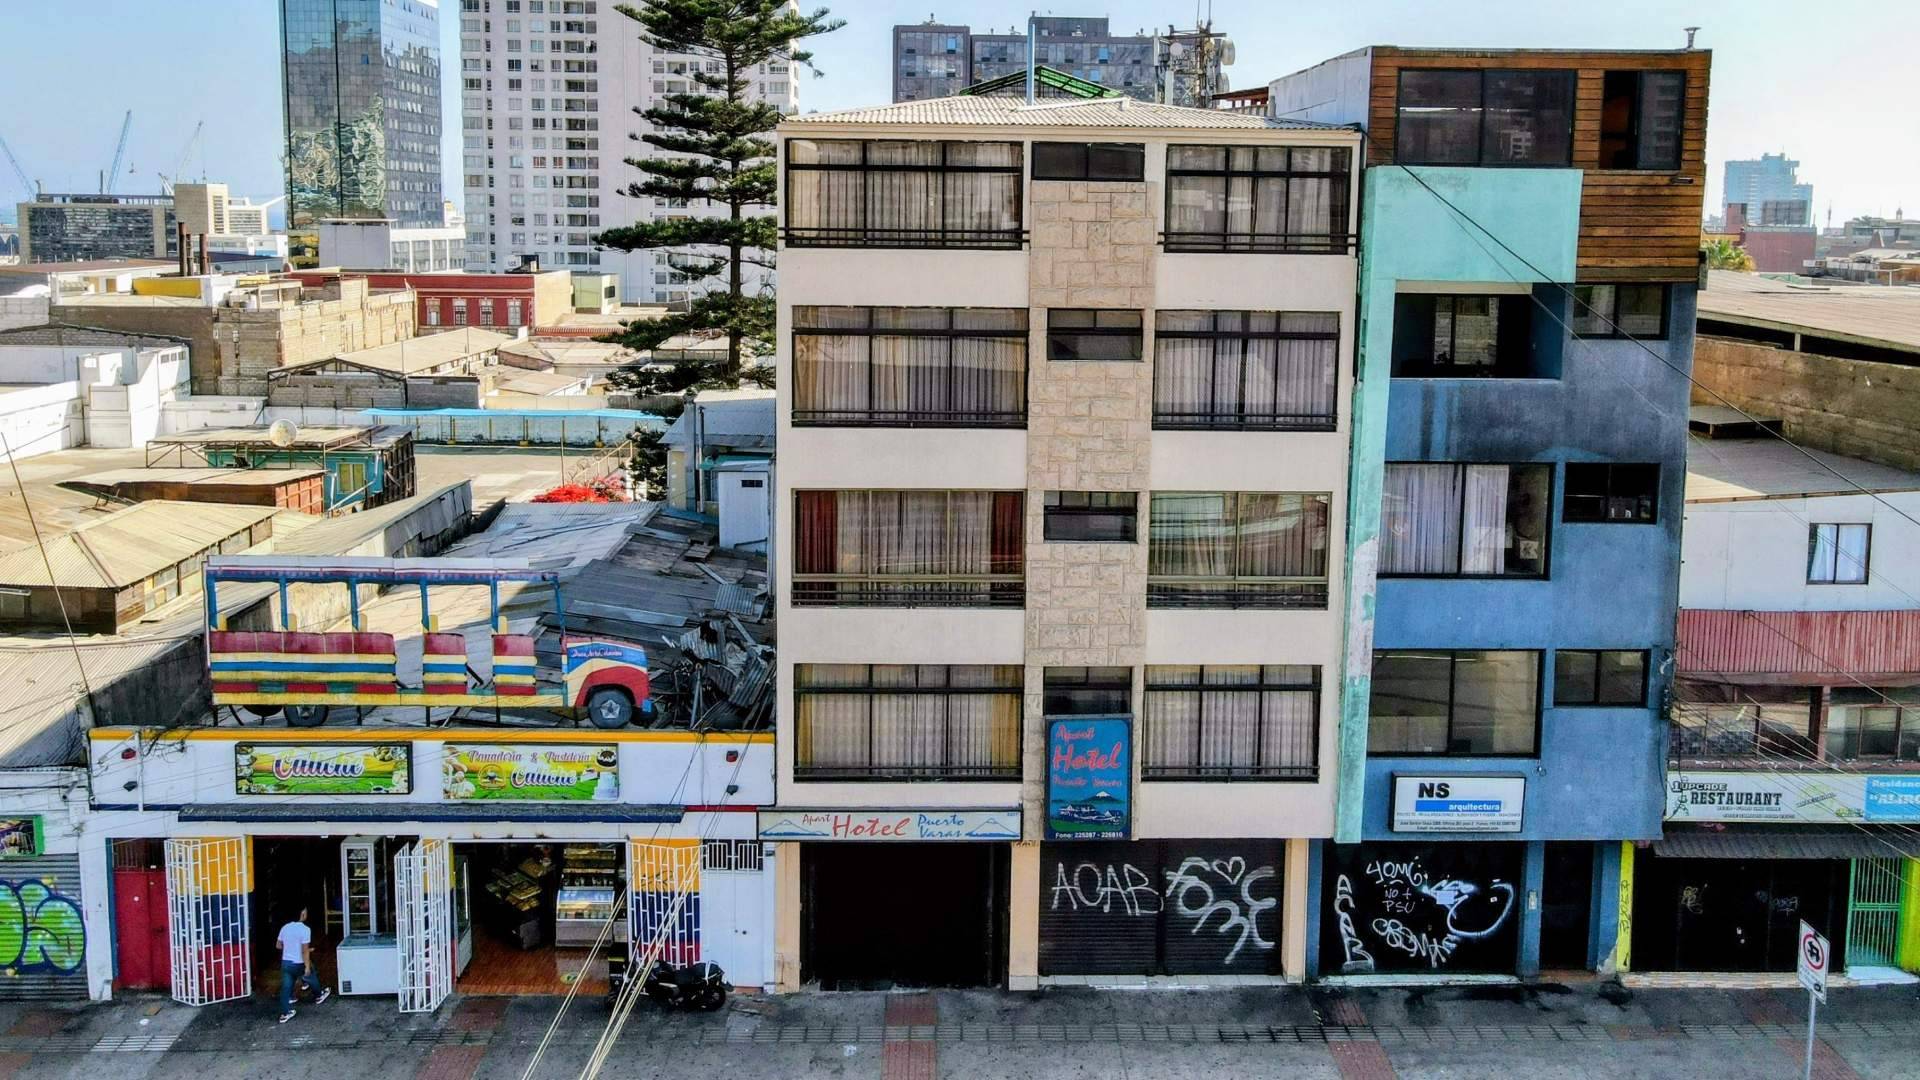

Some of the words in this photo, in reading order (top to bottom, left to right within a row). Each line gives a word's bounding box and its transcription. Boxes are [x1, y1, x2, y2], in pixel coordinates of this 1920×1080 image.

[1053, 742, 1122, 772] Hotel
[1418, 783, 1451, 798] NS
[1690, 792, 1783, 805] RESTAURANT
[1448, 802, 1500, 813] arquitectura
[802, 814, 831, 825] Apart
[832, 814, 911, 838] Hotel
[917, 814, 965, 826] Puerto
[918, 825, 962, 838] Varas
